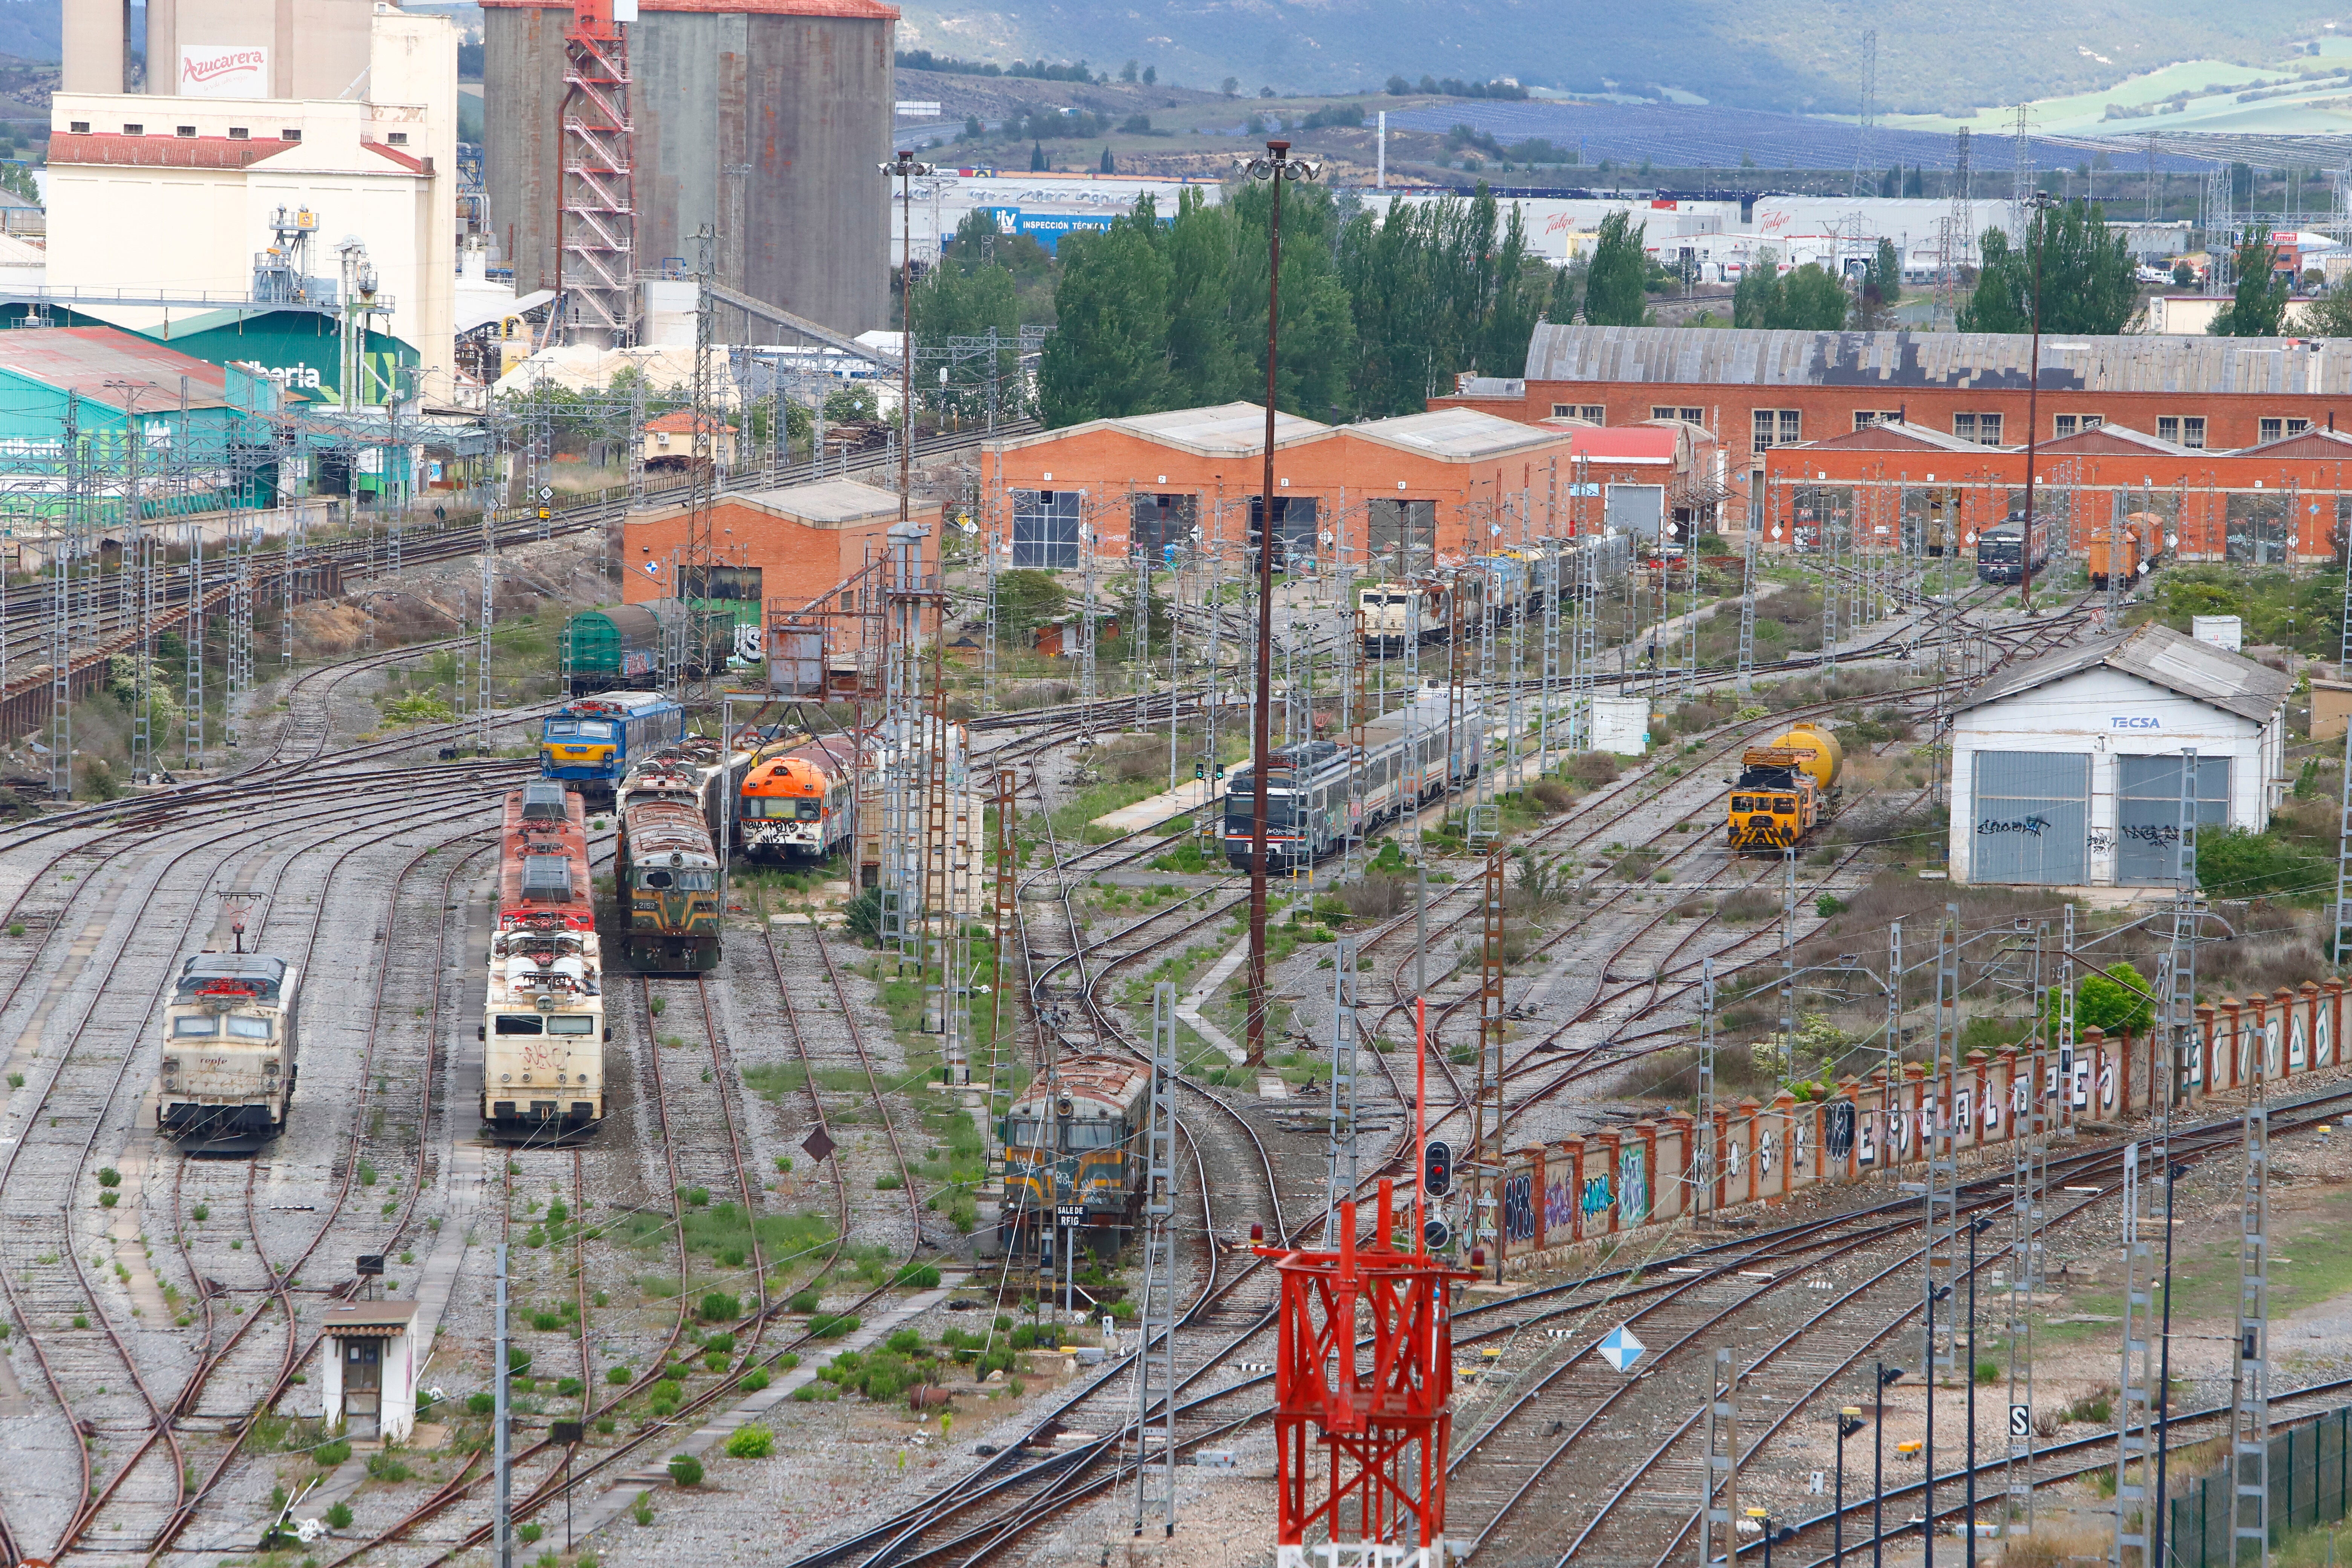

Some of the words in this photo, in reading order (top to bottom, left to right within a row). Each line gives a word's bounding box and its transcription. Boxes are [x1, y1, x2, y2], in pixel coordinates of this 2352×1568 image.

[182, 51, 264, 82] Azucarera
[1023, 221, 1065, 230] INSPECCIÓN
[1545, 212, 1576, 235] Talgo
[1761, 211, 1791, 233] Talgo
[2092, 610, 2105, 621] ALTO
[2111, 717, 2160, 728] TECSA
[200, 1057, 227, 1067] renfe
[1057, 1206, 1074, 1215] SALE
[1075, 1207, 1083, 1215] DE
[1061, 1216, 1079, 1226] RFIG
[2012, 1407, 2027, 1435] S
